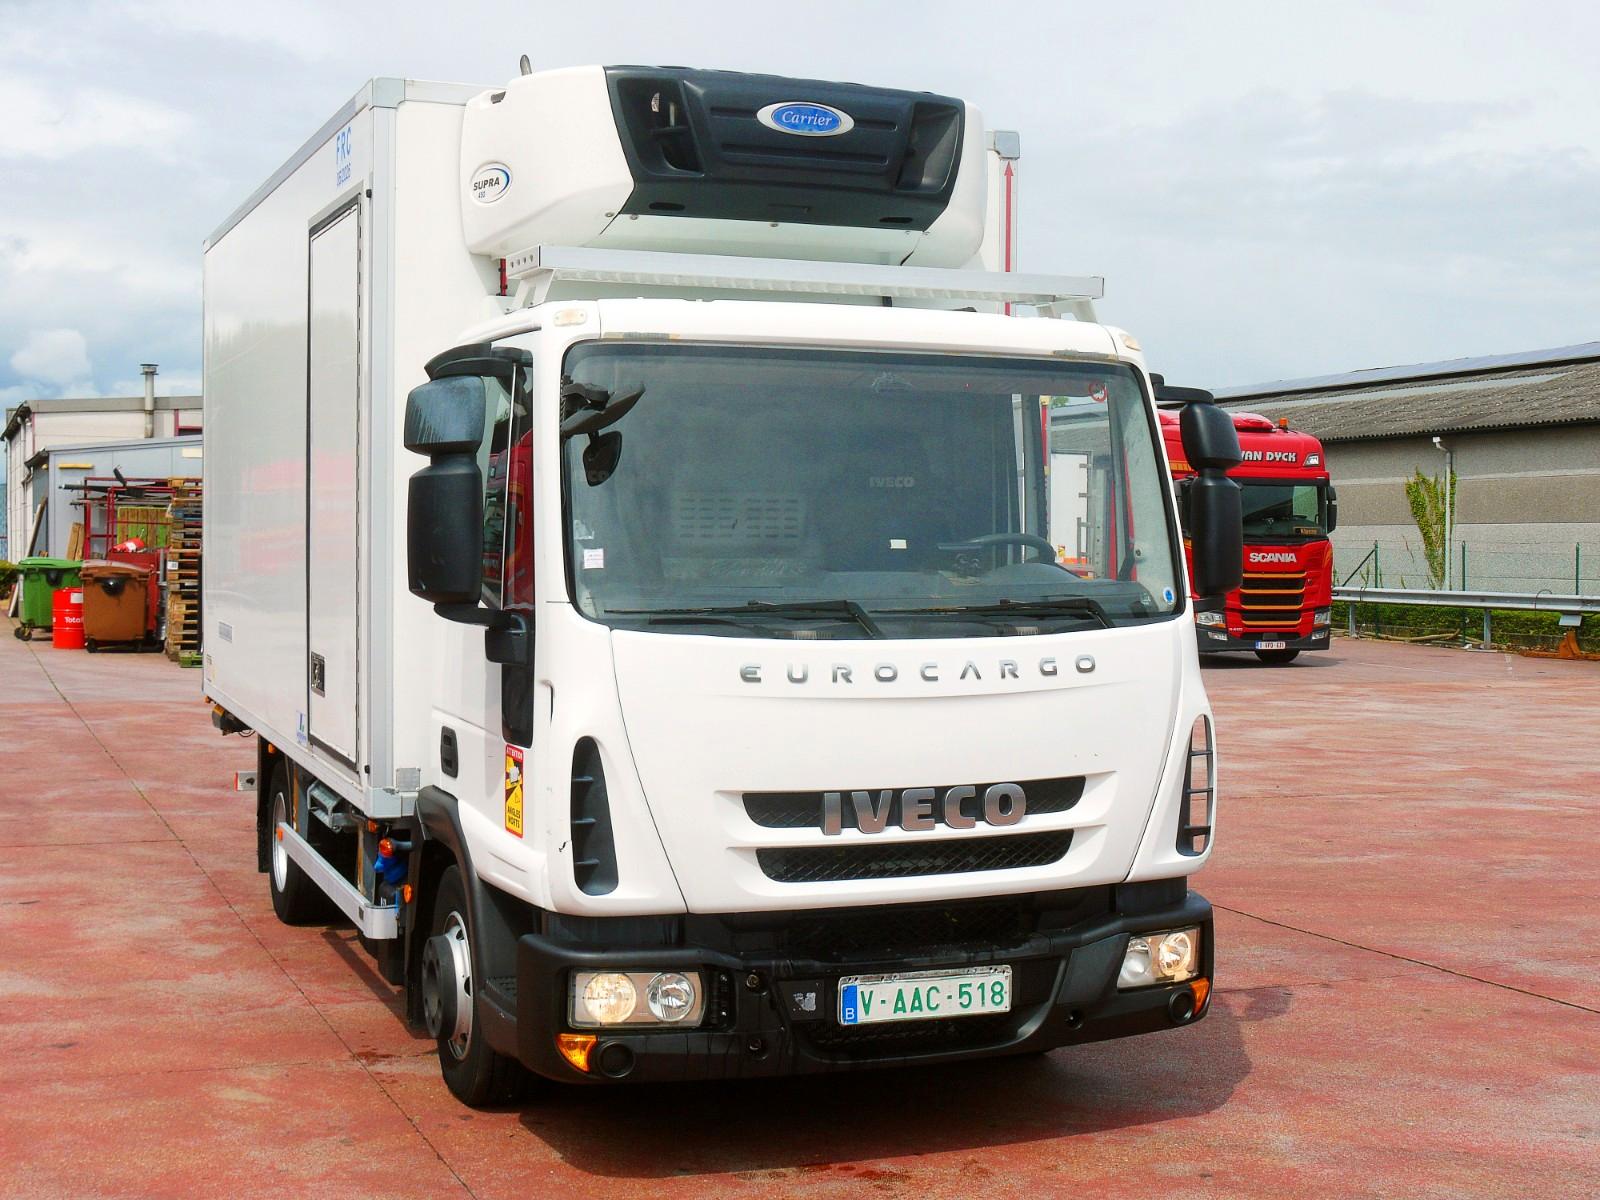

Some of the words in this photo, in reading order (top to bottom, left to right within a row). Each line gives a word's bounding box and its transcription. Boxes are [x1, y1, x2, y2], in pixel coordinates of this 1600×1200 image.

[782, 111, 832, 126] Carrier
[336, 126, 352, 164] FRC
[473, 176, 500, 191] SUPRA
[1266, 452, 1297, 462] DYCK
[1249, 552, 1297, 563] SCANIA
[739, 654, 1096, 684] EUROCARGO
[820, 782, 1027, 836] IVECO
[845, 1008, 855, 1020] B
